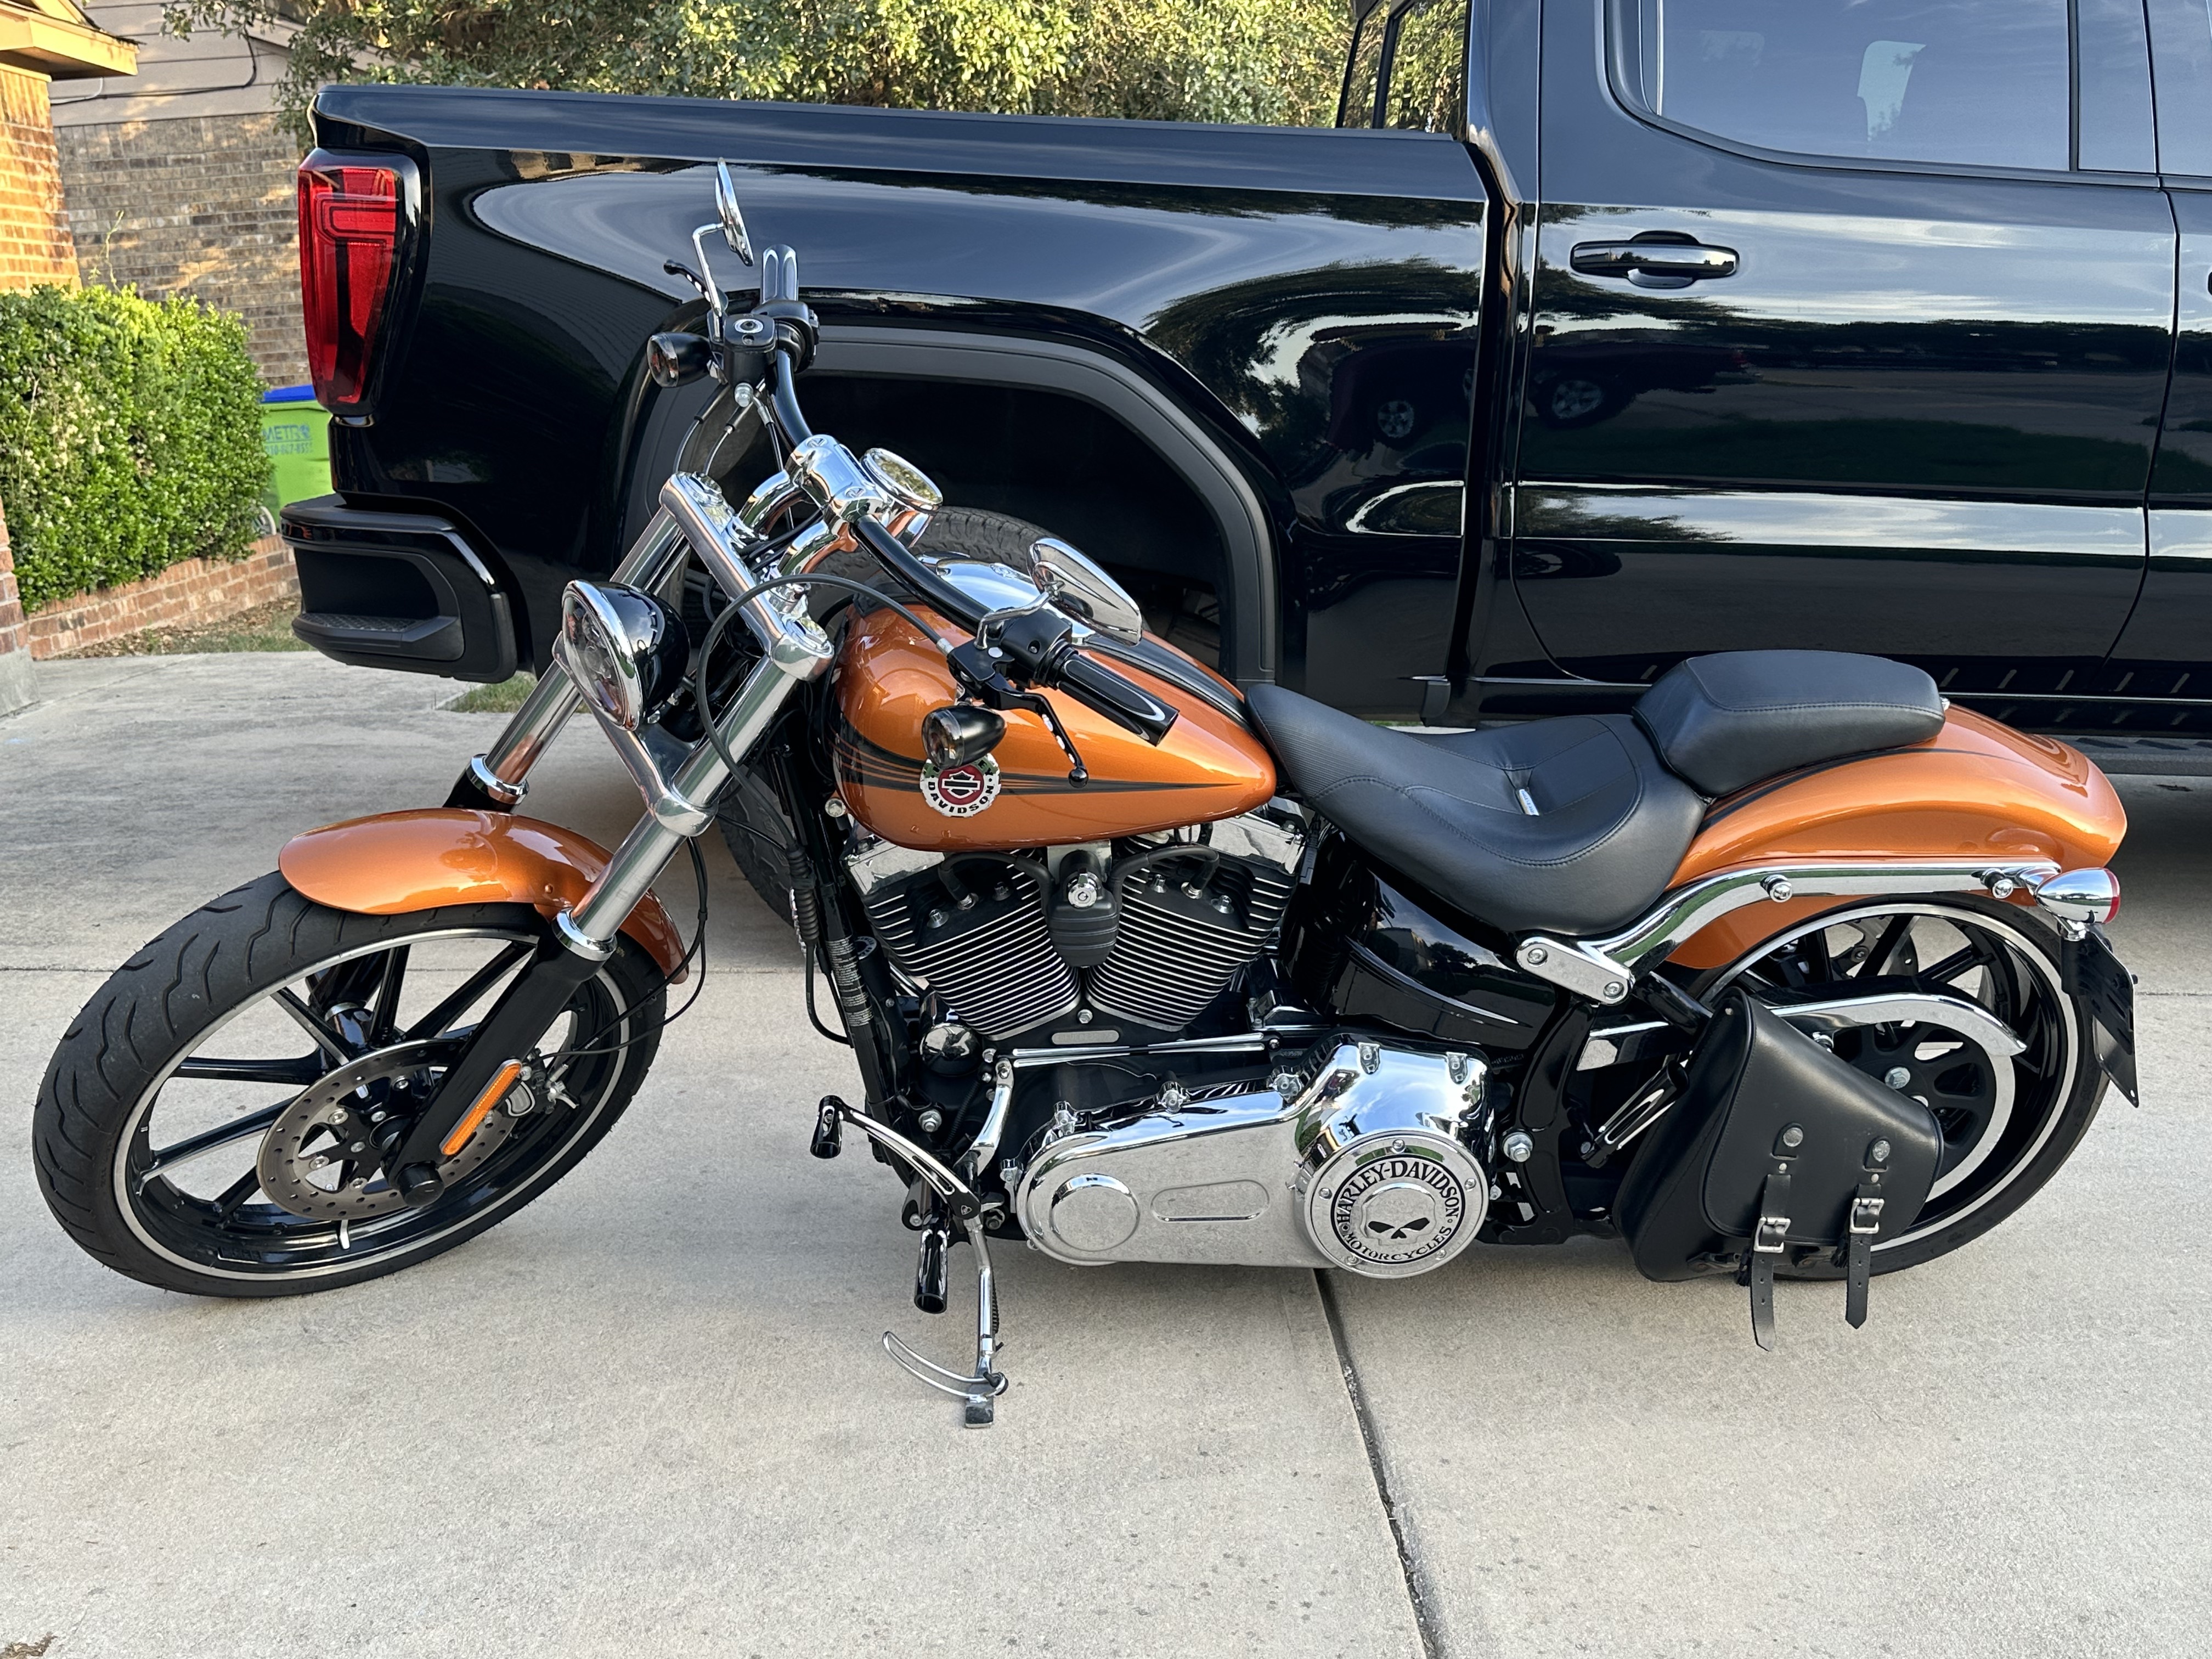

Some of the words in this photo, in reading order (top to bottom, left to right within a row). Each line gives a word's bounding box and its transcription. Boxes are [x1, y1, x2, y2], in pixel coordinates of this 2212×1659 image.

[928, 781, 995, 814] DAVIDSON
[1337, 1160, 1459, 1224] HARLEY-DAVIDSON
[1342, 1226, 1451, 1261] MOTORCYCLES
